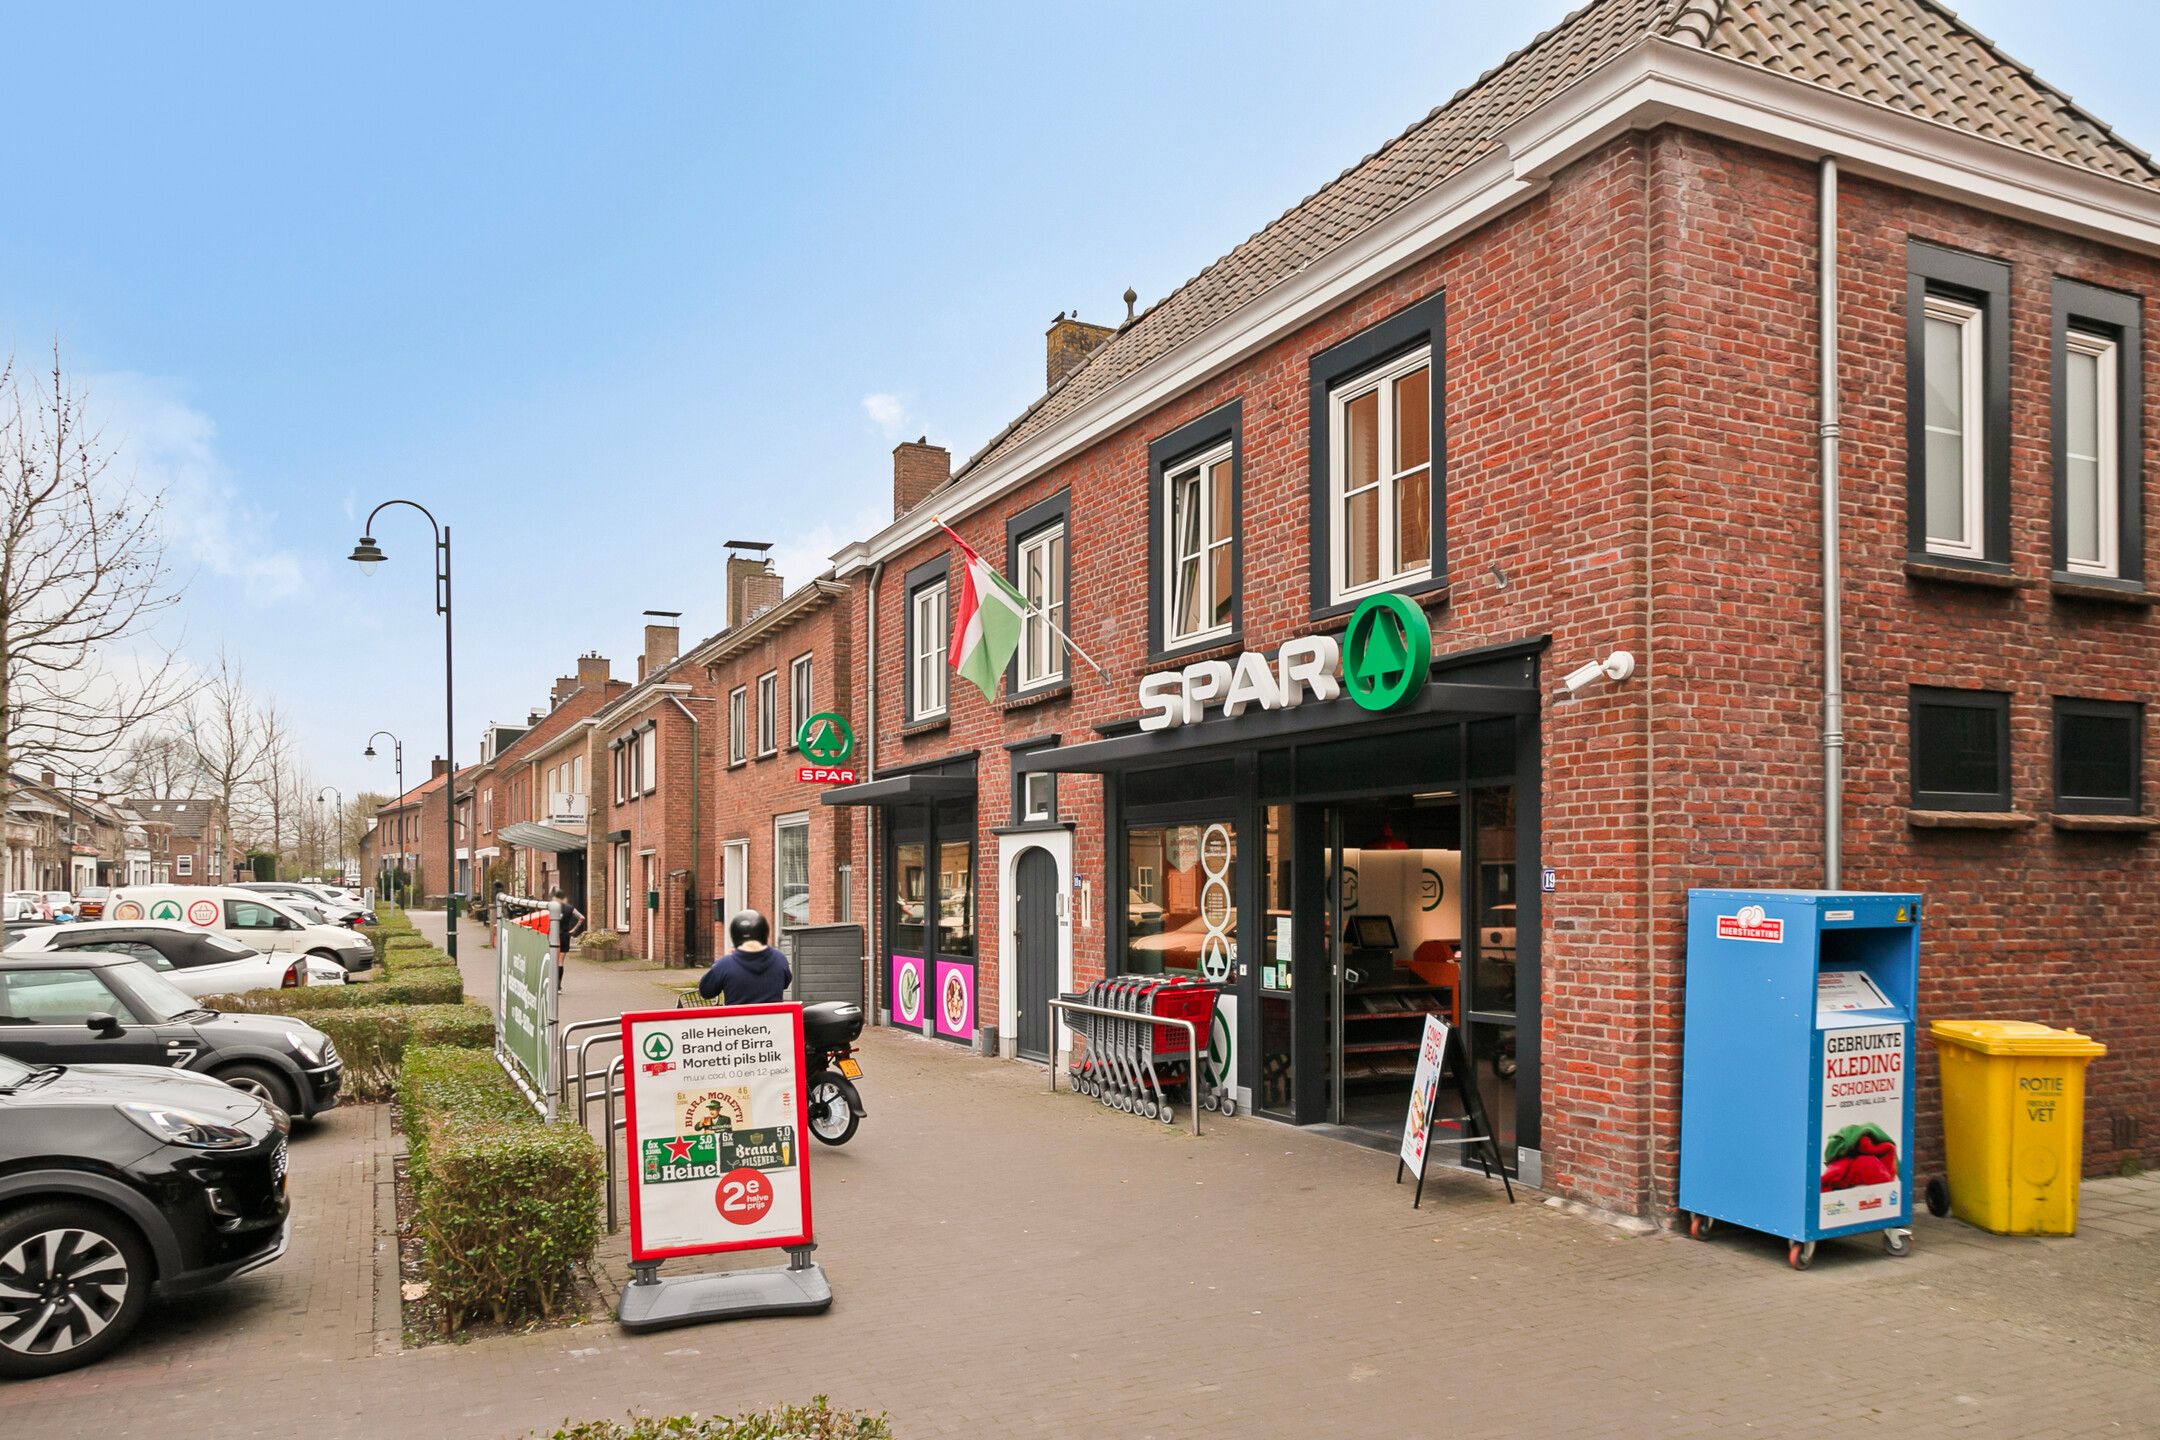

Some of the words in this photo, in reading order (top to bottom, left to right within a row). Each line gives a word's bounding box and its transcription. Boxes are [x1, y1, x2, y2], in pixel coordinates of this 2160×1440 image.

[1139, 635, 1340, 732] SPAR
[801, 769, 853, 782] SPAR
[1545, 872, 1555, 888] 19
[681, 1028, 704, 1040] alle
[706, 1024, 771, 1038] Heineken,
[682, 1041, 722, 1054] Brand
[725, 1039, 738, 1051] of
[741, 1038, 773, 1050] Birra
[1827, 1032, 1901, 1054] GEBRUIKTE
[683, 1053, 731, 1069] Moretti
[734, 1053, 756, 1067] pils
[759, 1051, 782, 1063] blik
[1826, 1053, 1901, 1079] KLEDING
[1831, 1078, 1896, 1097] SCHOENEN
[2019, 1077, 2064, 1091] ROTIE
[685, 1095, 706, 1128] BIRRA
[707, 1091, 744, 1123] MORETTI
[2027, 1108, 2056, 1122] VET
[699, 1134, 713, 1144] 5.0
[722, 1131, 734, 1142] 6x
[776, 1126, 791, 1137] 5.0
[647, 1140, 659, 1149] 6x
[736, 1142, 777, 1159] Brand
[747, 1194, 769, 1203] halve
[747, 1201, 766, 1211] prijs
